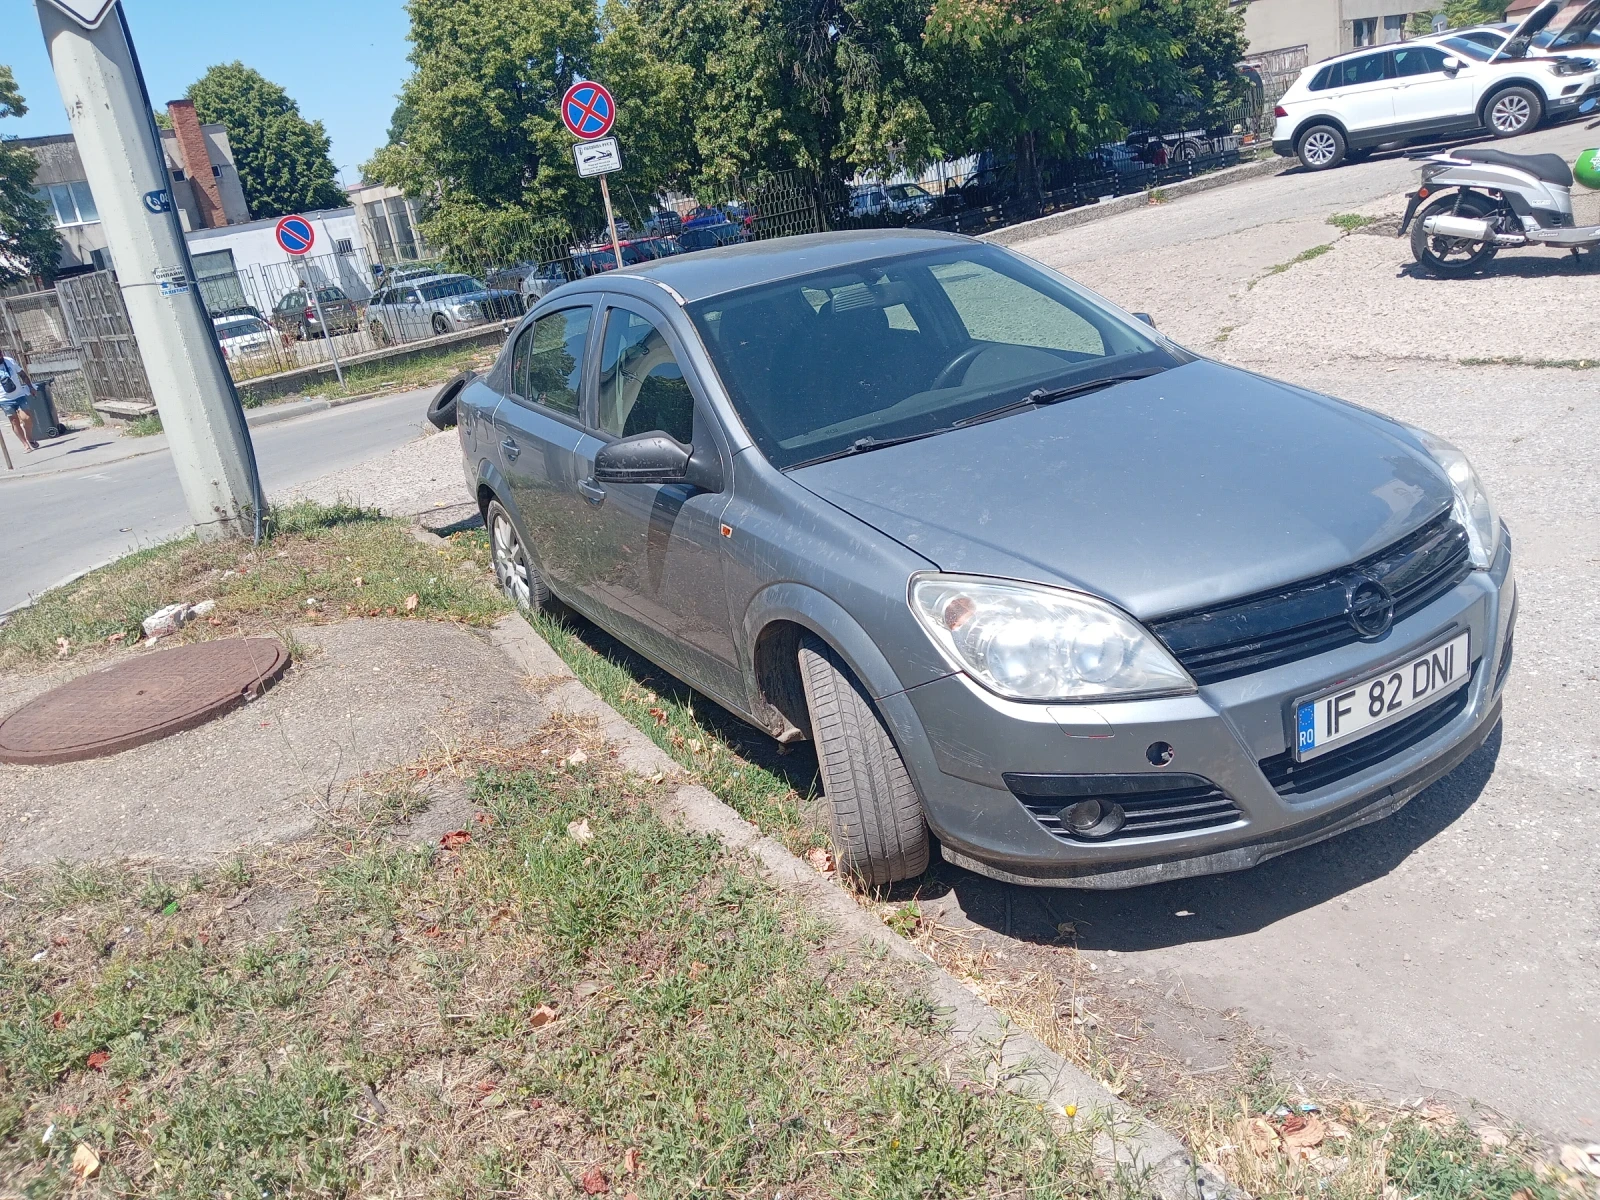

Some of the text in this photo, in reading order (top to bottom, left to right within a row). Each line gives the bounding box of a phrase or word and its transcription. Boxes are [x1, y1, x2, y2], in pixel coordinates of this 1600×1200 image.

[1326, 643, 1454, 738] IF 82 DNI
[1300, 728, 1314, 747] RO
